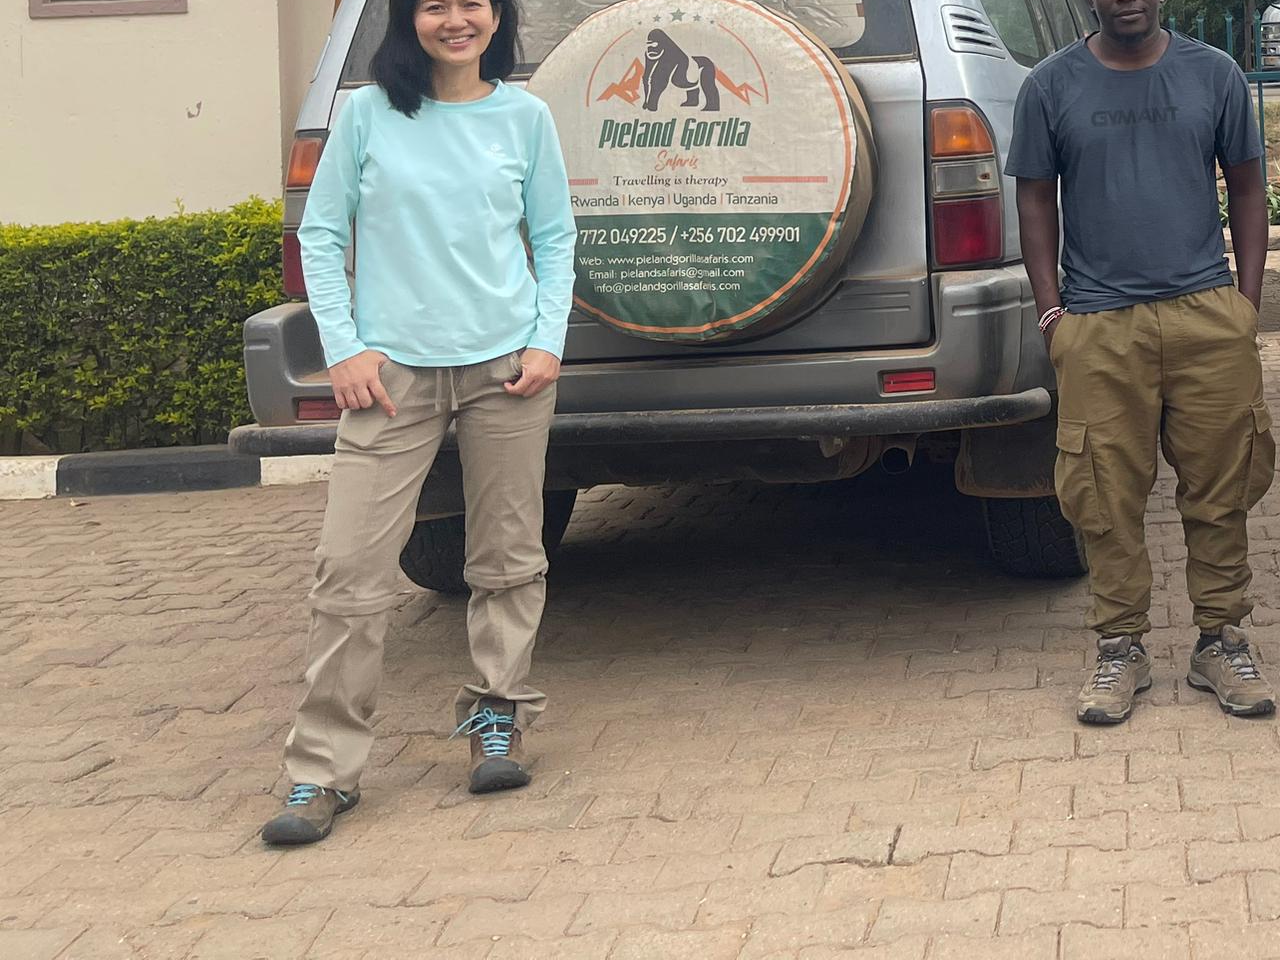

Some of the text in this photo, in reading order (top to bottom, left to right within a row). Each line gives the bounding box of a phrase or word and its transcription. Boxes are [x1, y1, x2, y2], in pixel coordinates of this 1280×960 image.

[598, 118, 751, 150] Pieland Gorilla
[654, 149, 699, 172] Safaris
[613, 175, 728, 187] Travelling is therapy
[571, 192, 778, 208] Rwanda kenya Uganda Tanzania
[580, 225, 800, 246] 772 049225 / +256 702 499901
[579, 253, 754, 266] Web: www.pielandgorillasafaris.com
[589, 267, 745, 280] Email: pielandsafaris@gmail.com
